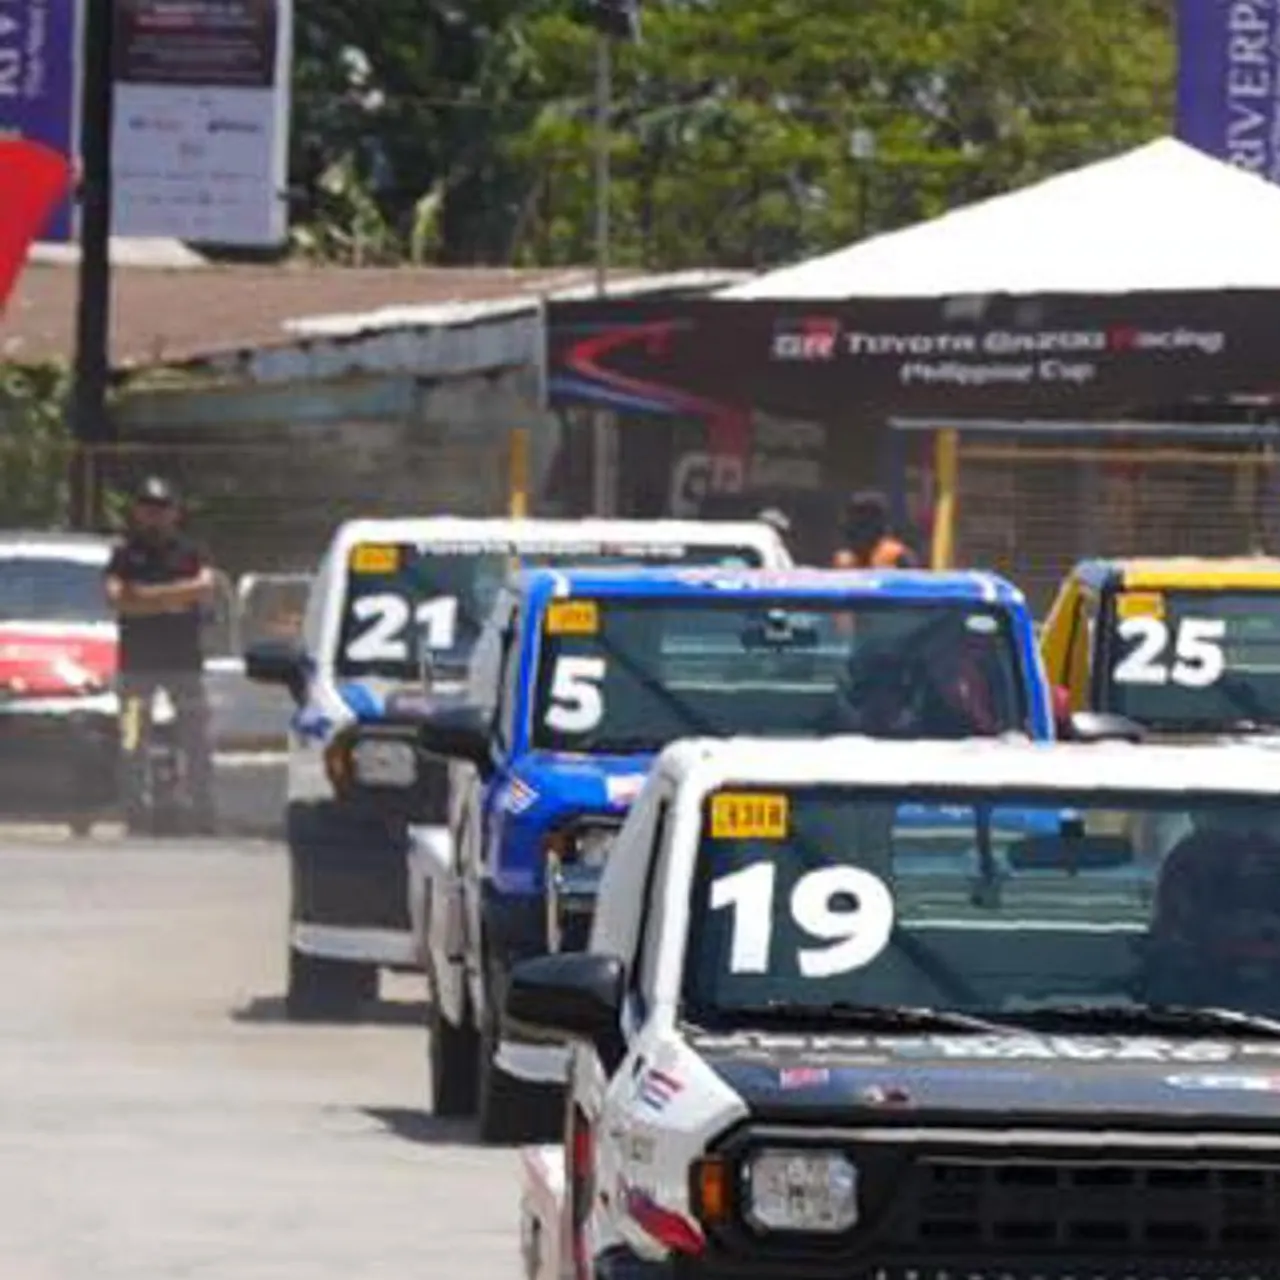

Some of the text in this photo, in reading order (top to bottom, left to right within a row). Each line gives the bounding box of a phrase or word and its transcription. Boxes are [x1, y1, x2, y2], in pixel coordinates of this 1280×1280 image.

[846, 332, 976, 355] TOYOTA
[346, 593, 457, 660] 21
[1114, 617, 1226, 687] 25
[545, 657, 607, 732] 5
[710, 861, 894, 978] 19
